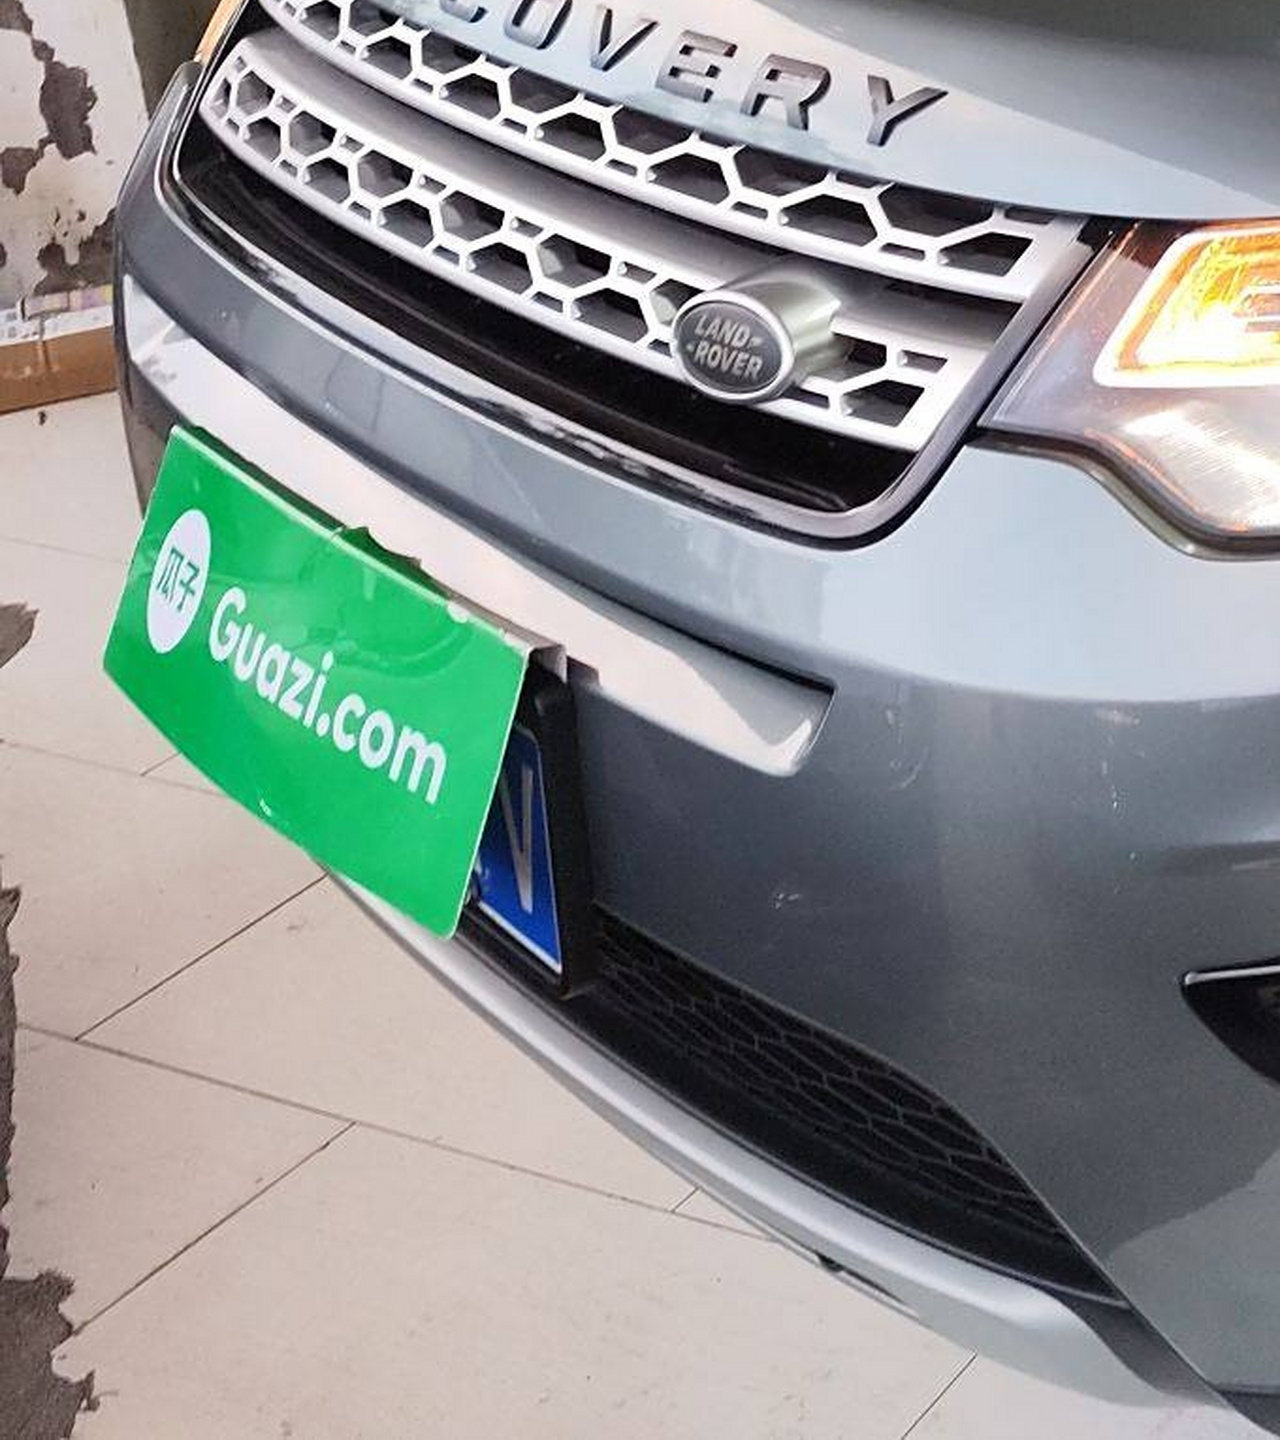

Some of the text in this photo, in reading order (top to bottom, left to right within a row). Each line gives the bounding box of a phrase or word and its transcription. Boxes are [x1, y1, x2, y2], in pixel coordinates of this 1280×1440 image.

[694, 314, 751, 347] LAND
[694, 340, 763, 380] ROVER
[156, 546, 200, 612] 瓜子
[208, 585, 447, 806] Guazi.com
